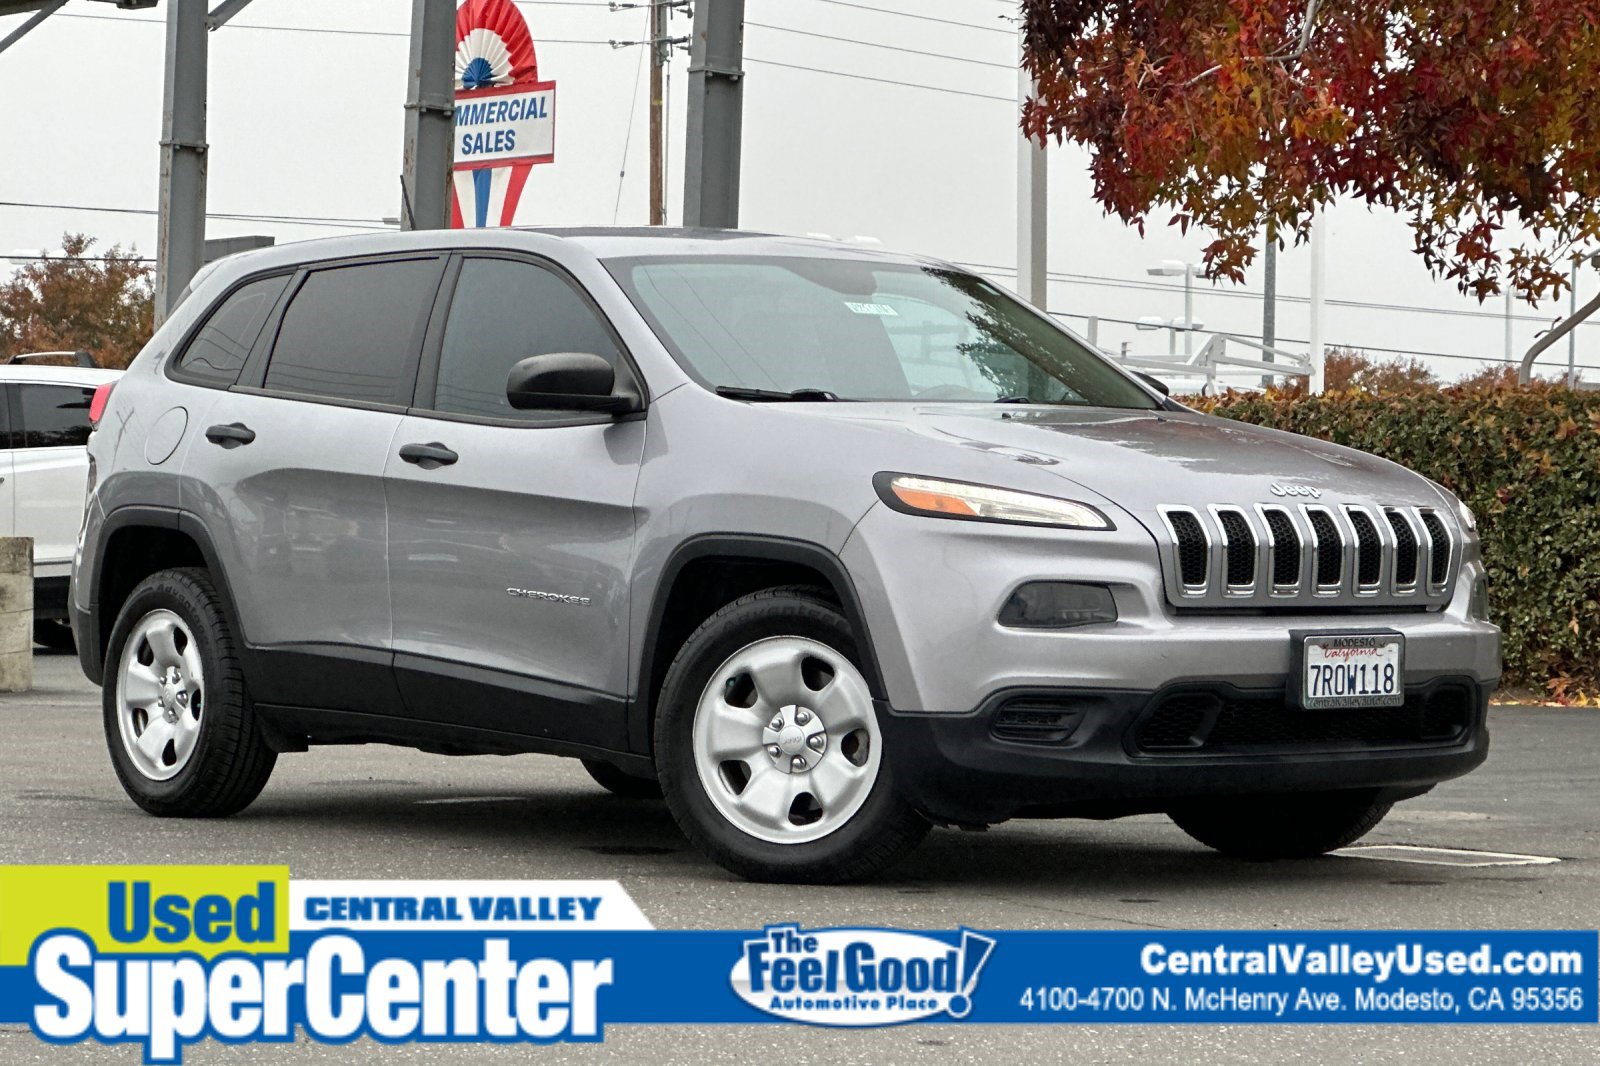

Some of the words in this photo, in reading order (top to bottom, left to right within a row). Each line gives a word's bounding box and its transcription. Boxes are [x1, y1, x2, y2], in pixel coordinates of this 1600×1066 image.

[454, 96, 548, 126] MMERCIAL
[461, 129, 516, 156] SALES
[1270, 482, 1322, 499] Jeep
[506, 587, 592, 606] CHEROKEE
[1333, 637, 1376, 648] MODESTO
[1324, 645, 1384, 662] California
[1310, 663, 1394, 696] 7ROW118
